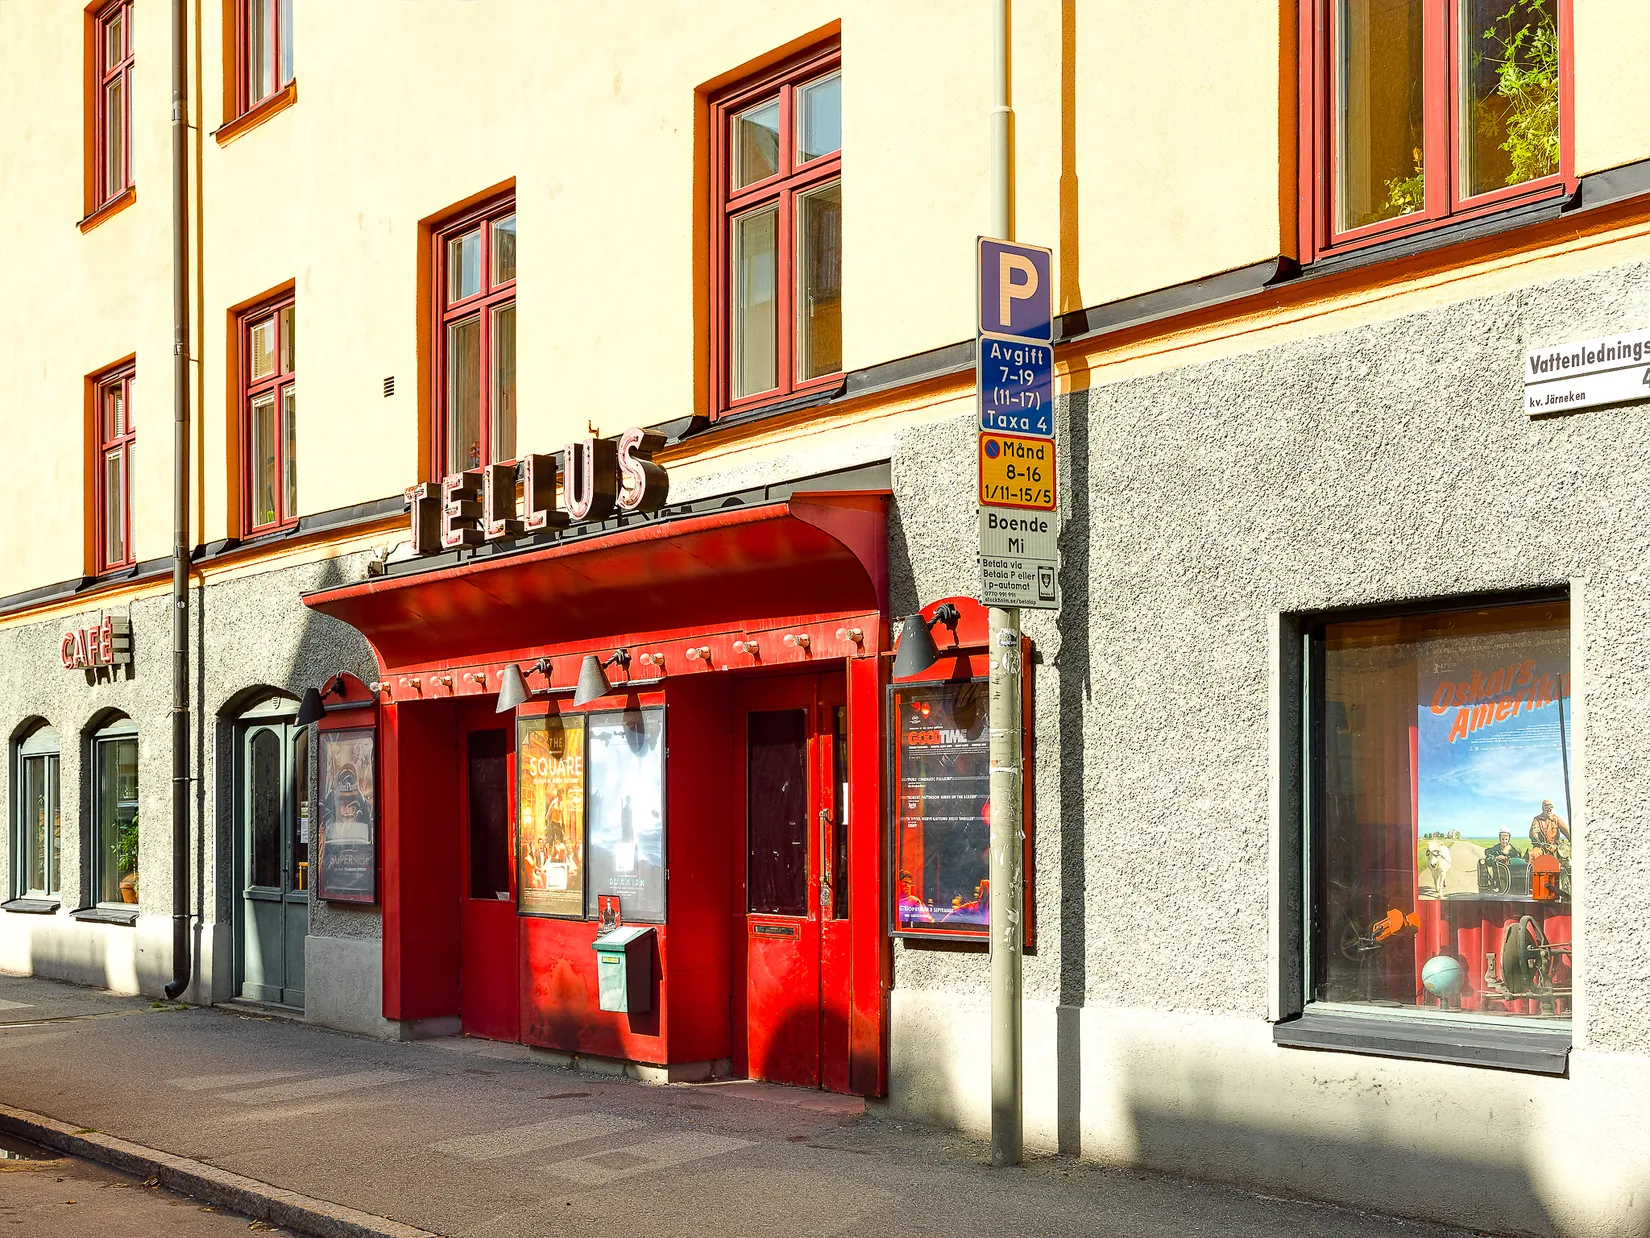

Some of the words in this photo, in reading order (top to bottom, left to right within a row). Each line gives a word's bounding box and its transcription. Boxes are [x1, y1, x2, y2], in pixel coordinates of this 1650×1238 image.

[1000, 252, 1038, 327] P
[990, 343, 1043, 366] Avgift
[1530, 341, 1650, 375] Vattenlednings
[1000, 366, 1034, 386] 7-19
[993, 386, 1041, 410] (11-17)
[1530, 398, 1543, 408] kv.
[1545, 391, 1586, 405] Järneken
[988, 410, 1029, 430] Taxa
[1037, 417, 1047, 432] 4
[1003, 441, 1044, 461] Månd
[1006, 464, 1041, 482] 8-16
[404, 427, 668, 555] TELLUS
[984, 484, 1051, 504] 1/11-15/5
[988, 513, 1048, 533] Boende
[1008, 538, 1024, 553] Mi
[983, 559, 1008, 568] Betala
[1010, 561, 1022, 569] via
[983, 570, 1008, 578] Betala
[1018, 572, 1035, 580] eller
[989, 582, 1030, 590] p-automat
[60, 616, 113, 670] CAFÉ
[1430, 660, 1536, 715] Oskars
[549, 737, 563, 748] THE
[529, 755, 582, 777] SQUARE
[609, 878, 645, 886] DUNKIRK
